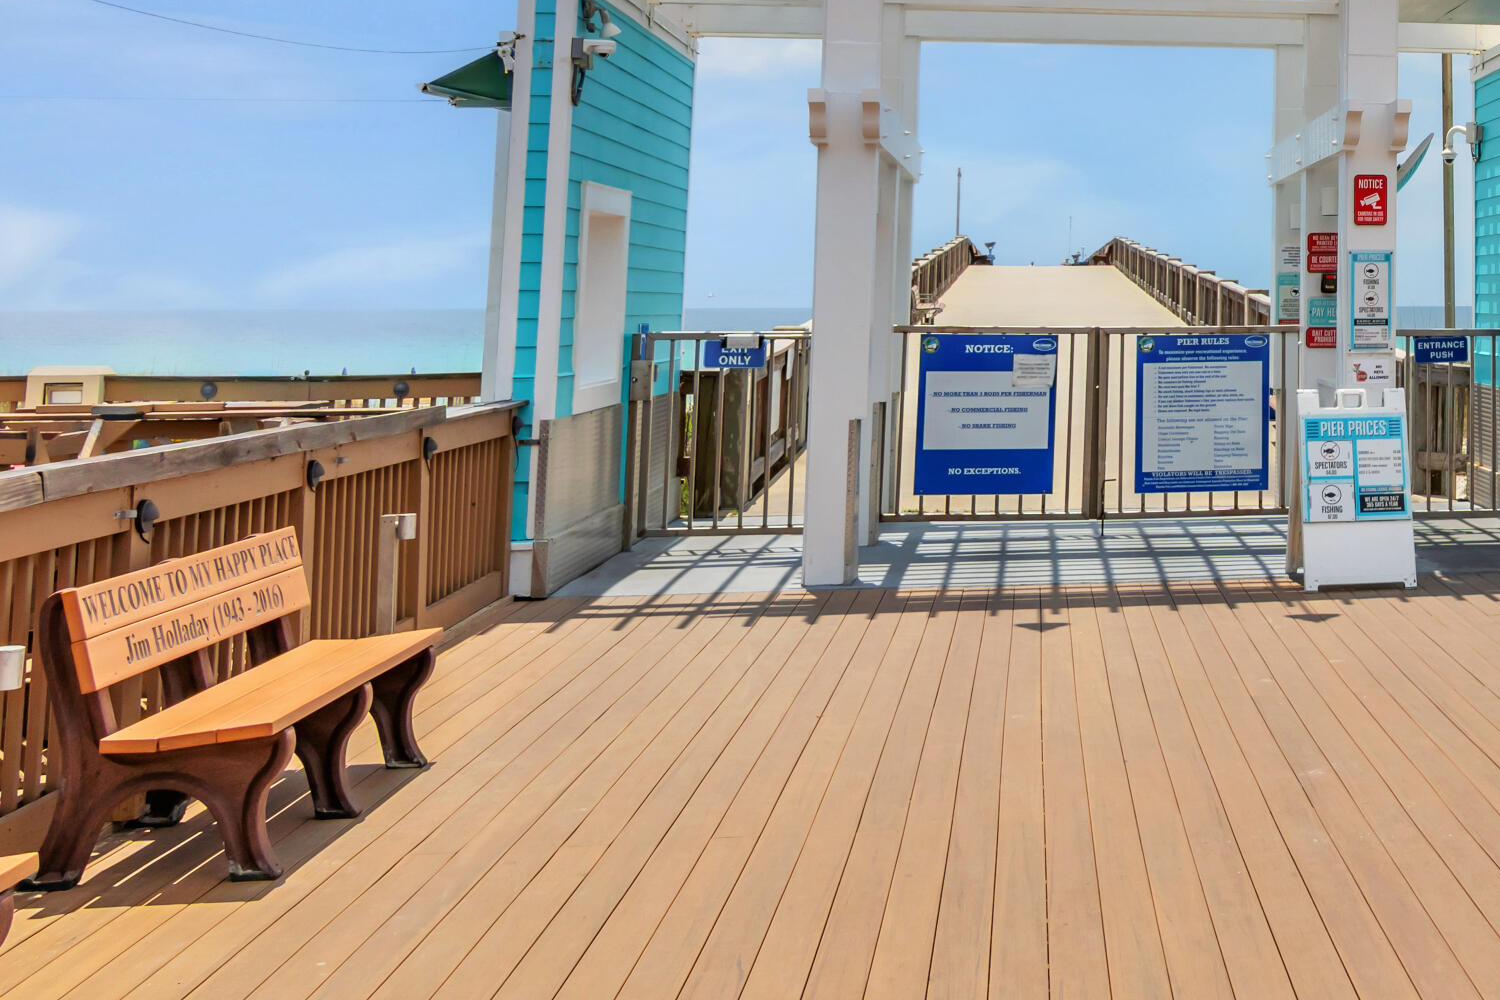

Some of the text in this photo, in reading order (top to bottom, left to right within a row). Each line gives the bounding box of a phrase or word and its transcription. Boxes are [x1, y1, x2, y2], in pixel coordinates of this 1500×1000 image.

[1358, 179, 1383, 189] NOTICE
[1177, 337, 1230, 346] PIER RULES
[1417, 341, 1464, 350] ENTRANCE
[965, 344, 1014, 353] NOTICE:
[1430, 351, 1453, 359] PUSH
[719, 355, 751, 365] ONLY
[1320, 420, 1387, 437] PIER PRICES
[1315, 461, 1347, 469] SPECTATORS
[964, 467, 1021, 475] EXCEPTIONS.
[82, 535, 299, 624] WELCOME TO MY HAPPY PLACE
[125, 634, 151, 664] Jim
[152, 614, 212, 654] Holladay
[212, 597, 245, 635] (1943
[253, 583, 285, 616] 2016)
